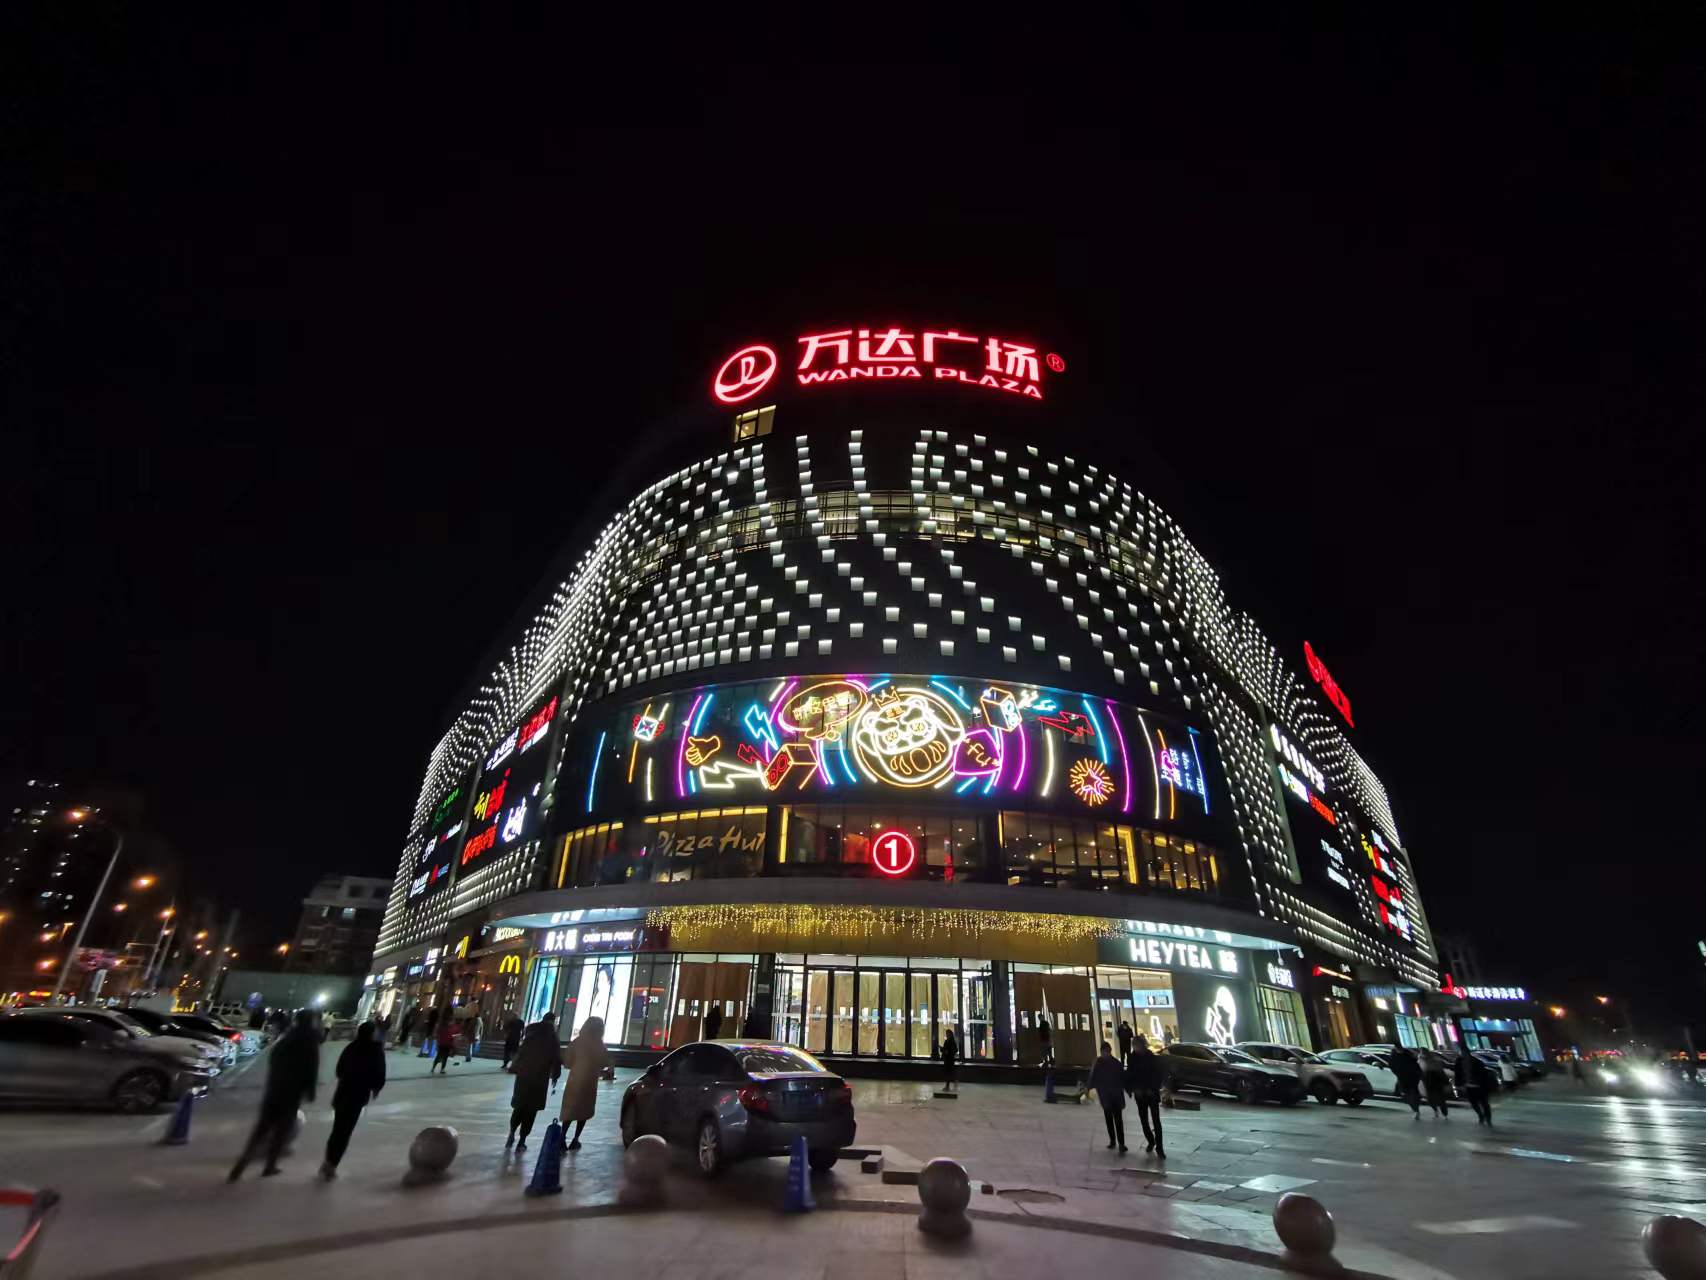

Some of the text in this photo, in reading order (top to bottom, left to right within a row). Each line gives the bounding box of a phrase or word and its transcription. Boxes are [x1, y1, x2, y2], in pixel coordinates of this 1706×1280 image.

[797, 328, 1040, 382] 万达广场
[797, 365, 1043, 399] WANDA PLAZA
[658, 825, 766, 858] Pizza Hut
[1129, 937, 1214, 971] HEYTEA
